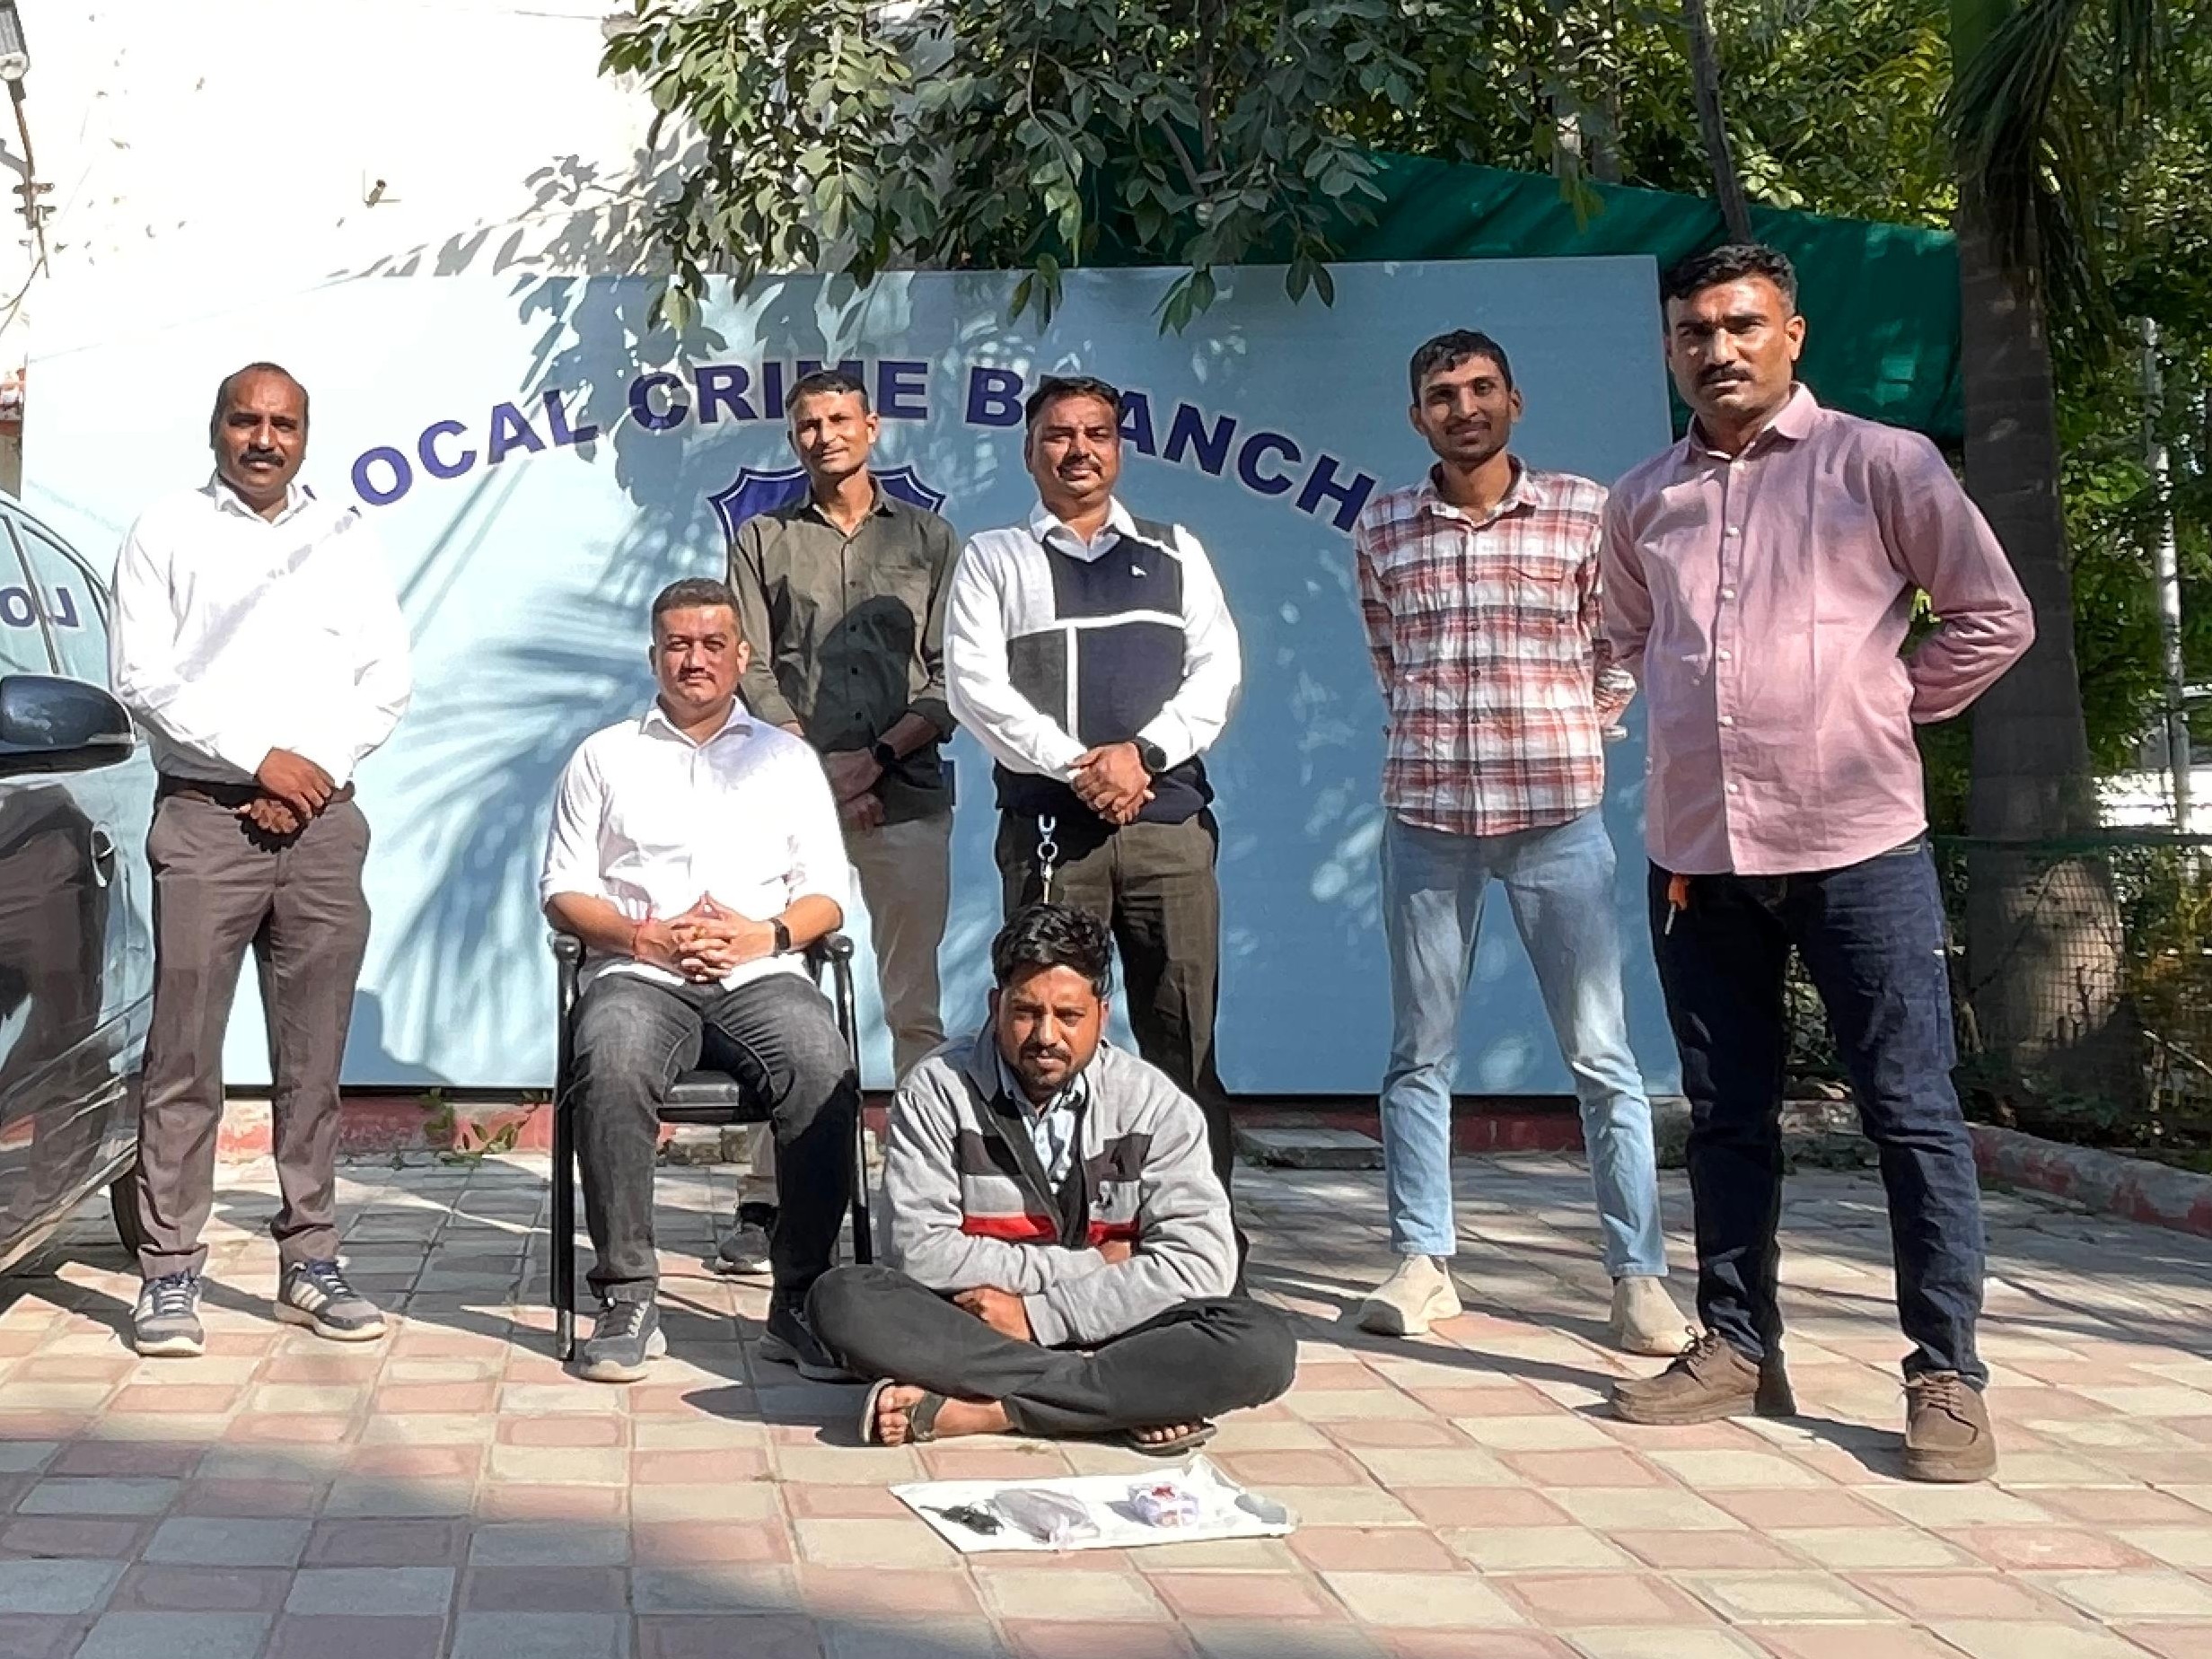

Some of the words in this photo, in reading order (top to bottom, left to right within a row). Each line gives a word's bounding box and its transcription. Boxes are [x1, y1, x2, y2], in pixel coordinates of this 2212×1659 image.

[303, 389, 599, 520] OCAL
[629, 360, 928, 430] CRIE
[965, 365, 1376, 532] BANCH
